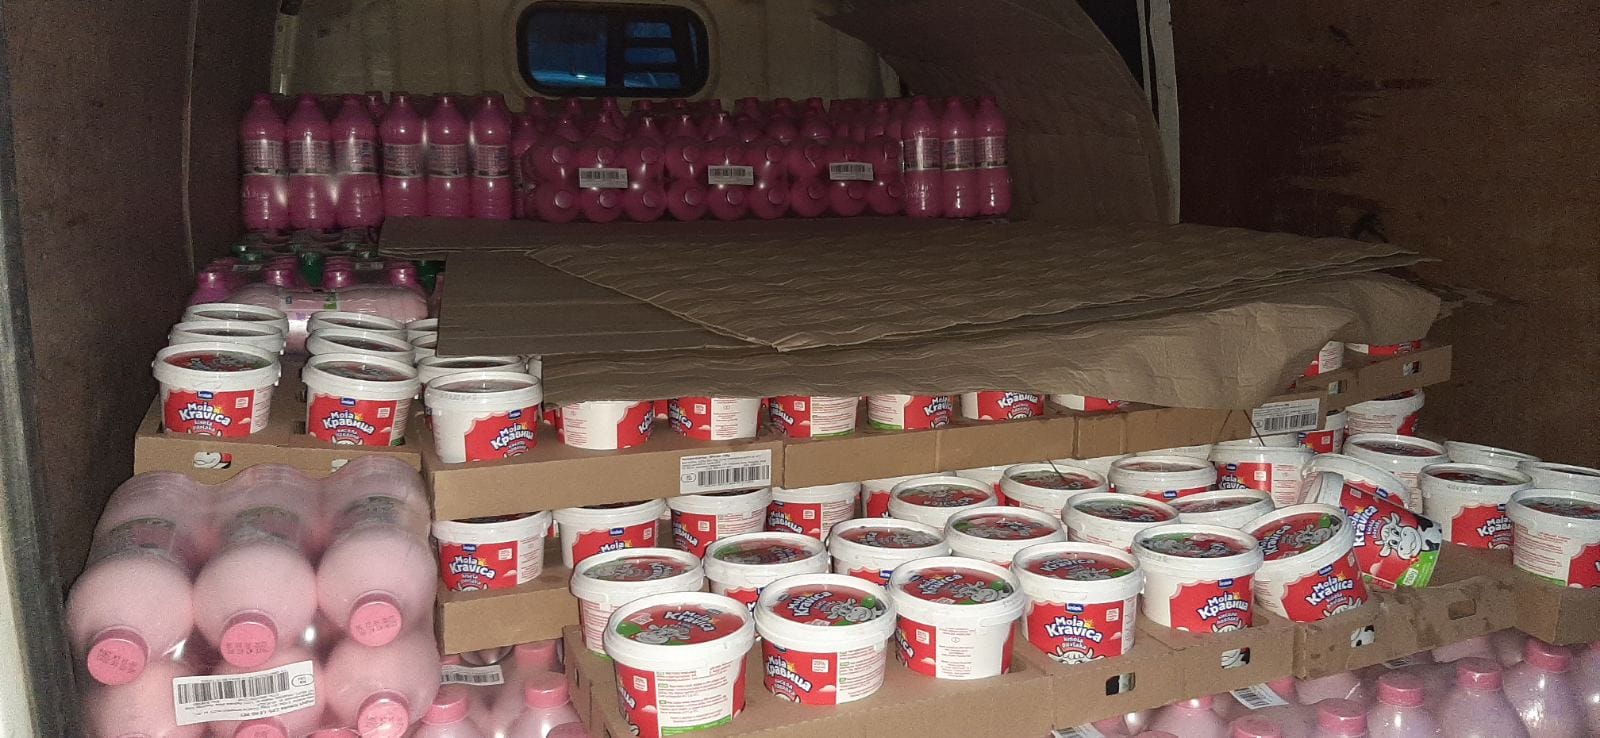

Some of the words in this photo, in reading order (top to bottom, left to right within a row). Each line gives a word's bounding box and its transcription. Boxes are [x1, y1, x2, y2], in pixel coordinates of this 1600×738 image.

[178, 409, 231, 426] Kravica
[322, 418, 375, 434] Кравица
[1352, 505, 1378, 547] Kravica
[449, 563, 496, 579] Kravica
[1305, 580, 1354, 606] Kravica
[1055, 615, 1084, 627] Moja
[1045, 624, 1103, 643] Kravica
